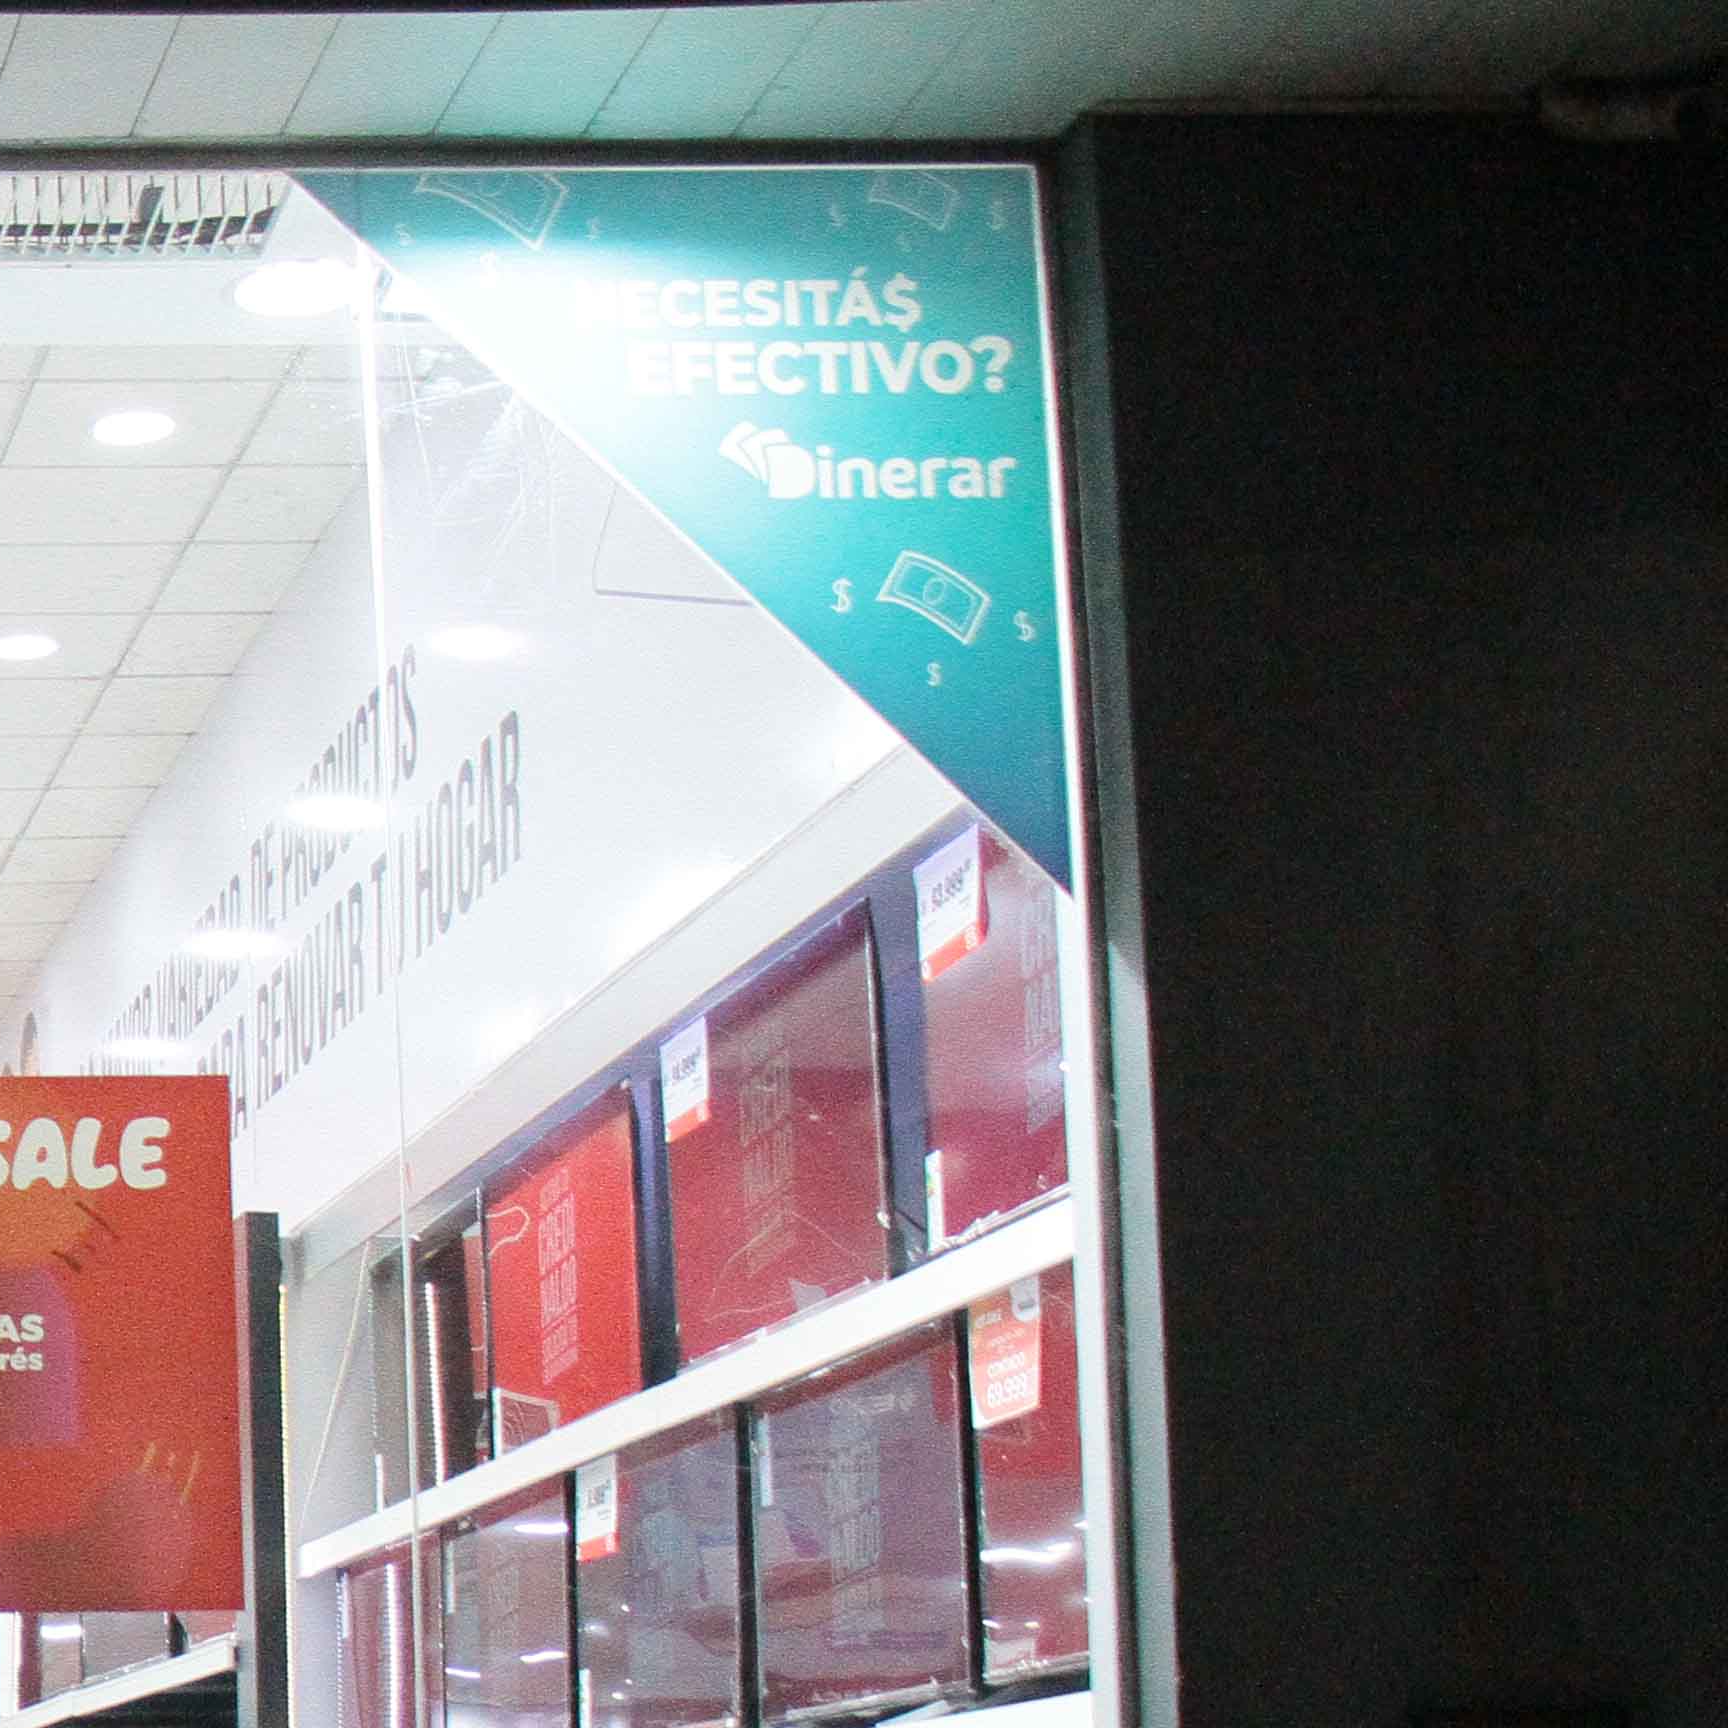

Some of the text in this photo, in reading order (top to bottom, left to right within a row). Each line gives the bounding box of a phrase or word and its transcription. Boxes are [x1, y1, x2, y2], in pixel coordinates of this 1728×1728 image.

[625, 336, 1012, 395] EFECTIVO?
[764, 443, 1018, 501] Dinerar
[257, 880, 364, 1110] RENOVAR
[415, 710, 520, 960] HOGAR
